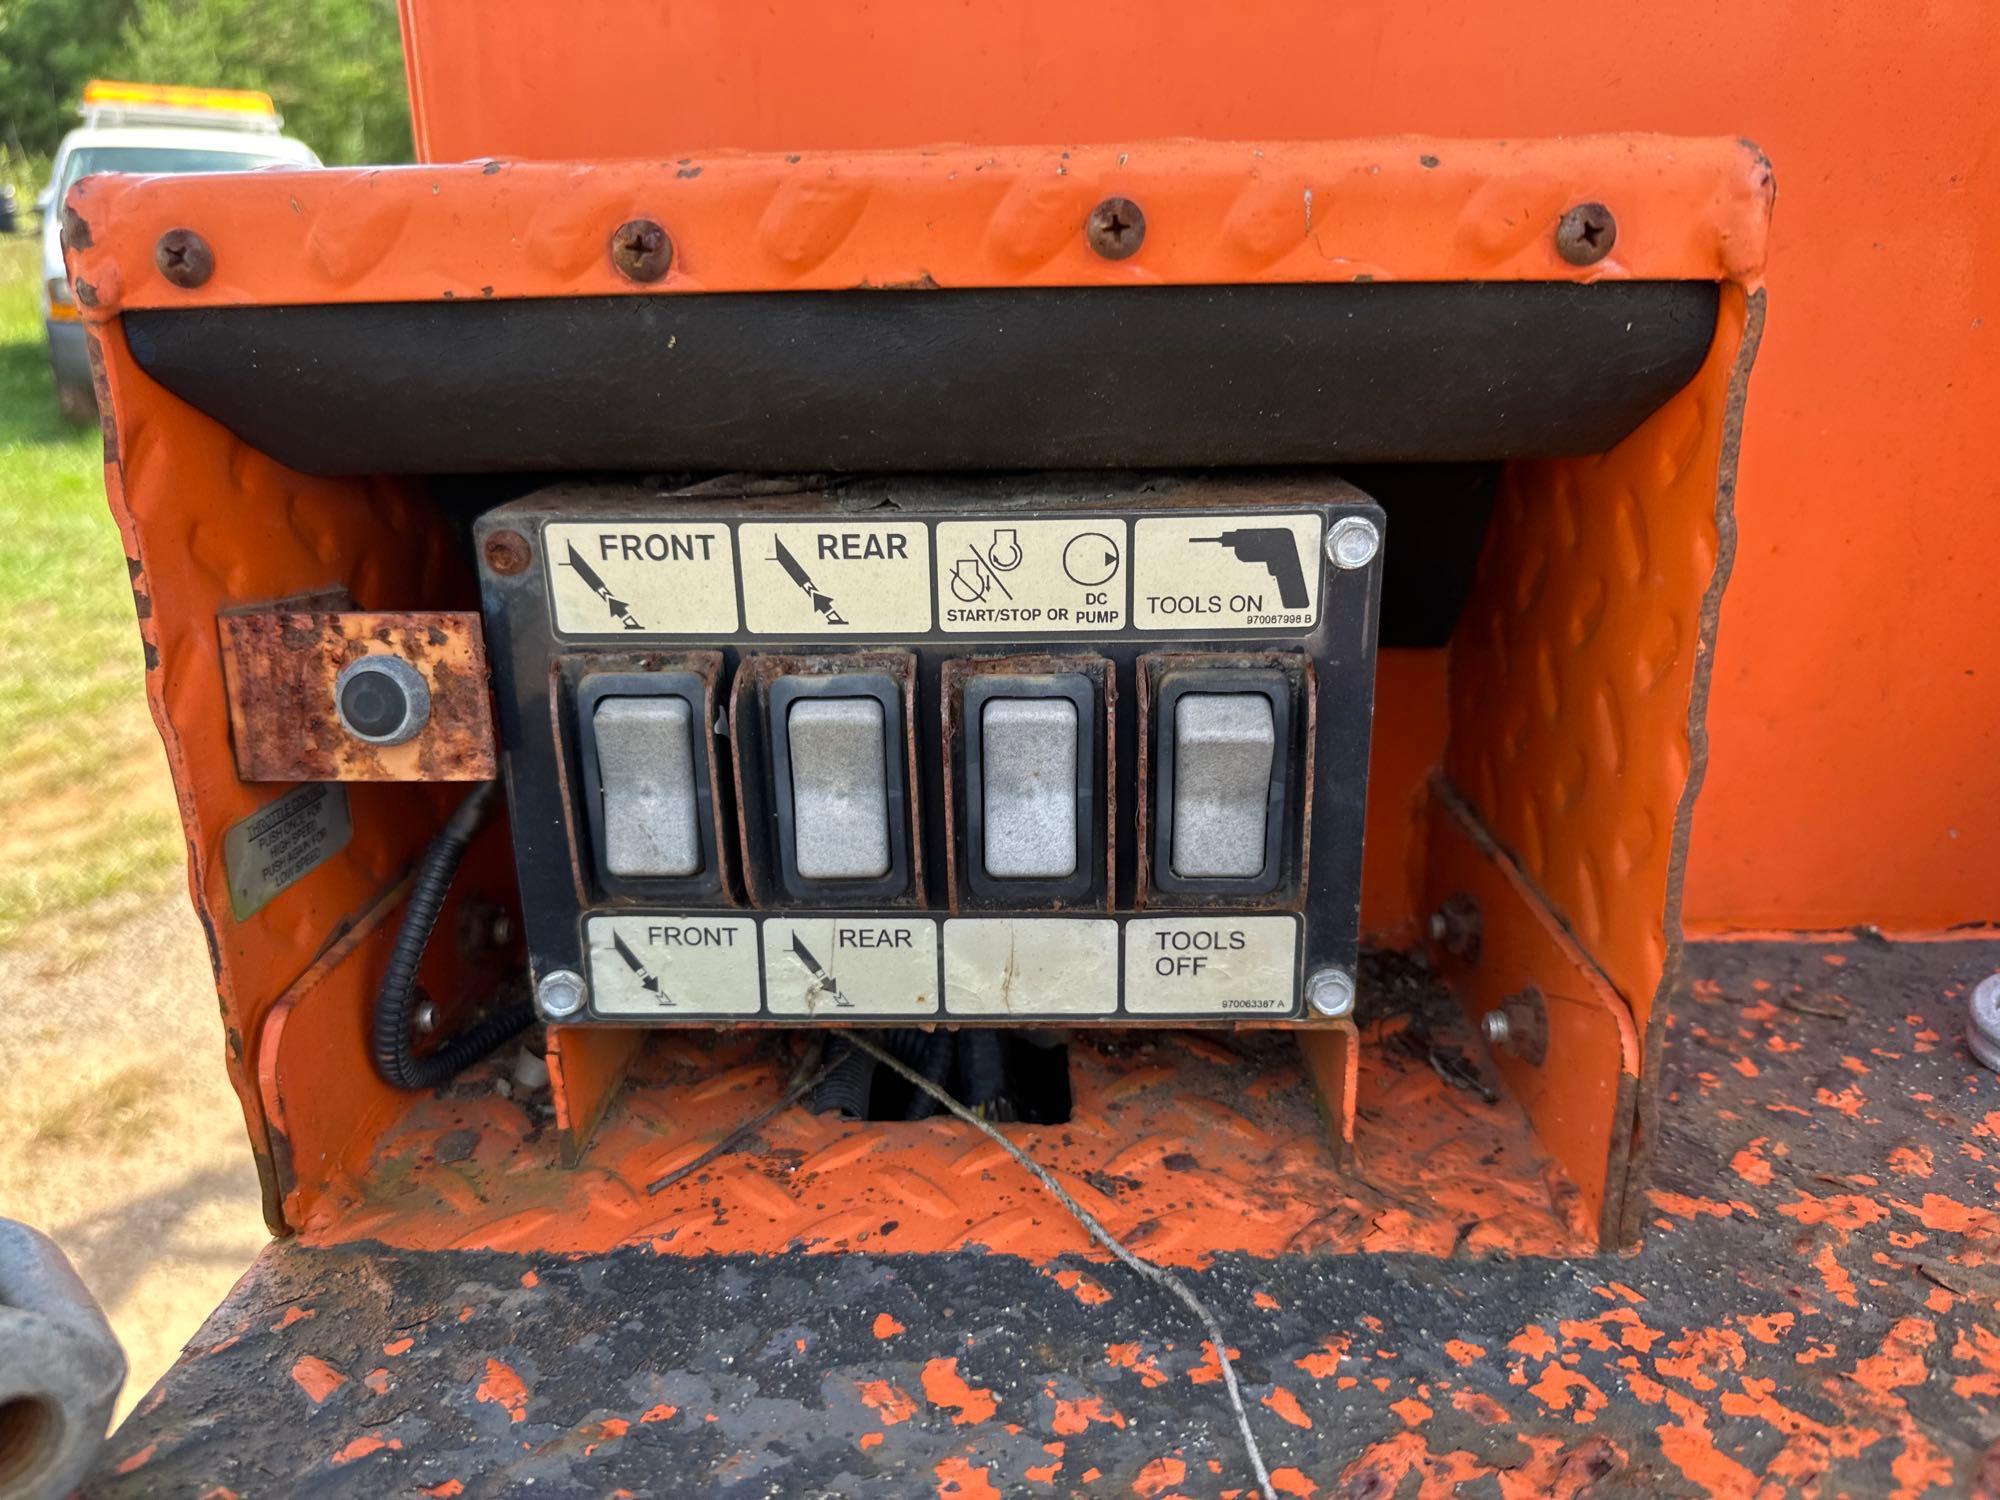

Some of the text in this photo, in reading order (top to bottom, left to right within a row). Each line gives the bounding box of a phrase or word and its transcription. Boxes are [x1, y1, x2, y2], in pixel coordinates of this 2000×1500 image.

[599, 534, 715, 561] FRONT
[817, 533, 908, 560] REAR
[1085, 593, 1108, 606] DC
[1146, 595, 1263, 615] TOOLS ON
[946, 608, 1119, 624] START/STOP OR PUMP
[1247, 614, 1312, 624] 970067998 B
[648, 926, 738, 947] FRONT
[839, 928, 912, 948] REAR
[1155, 931, 1246, 951] TOOLS
[1155, 956, 1207, 976] OFF
[1222, 999, 1285, 1009] 970063387 A
